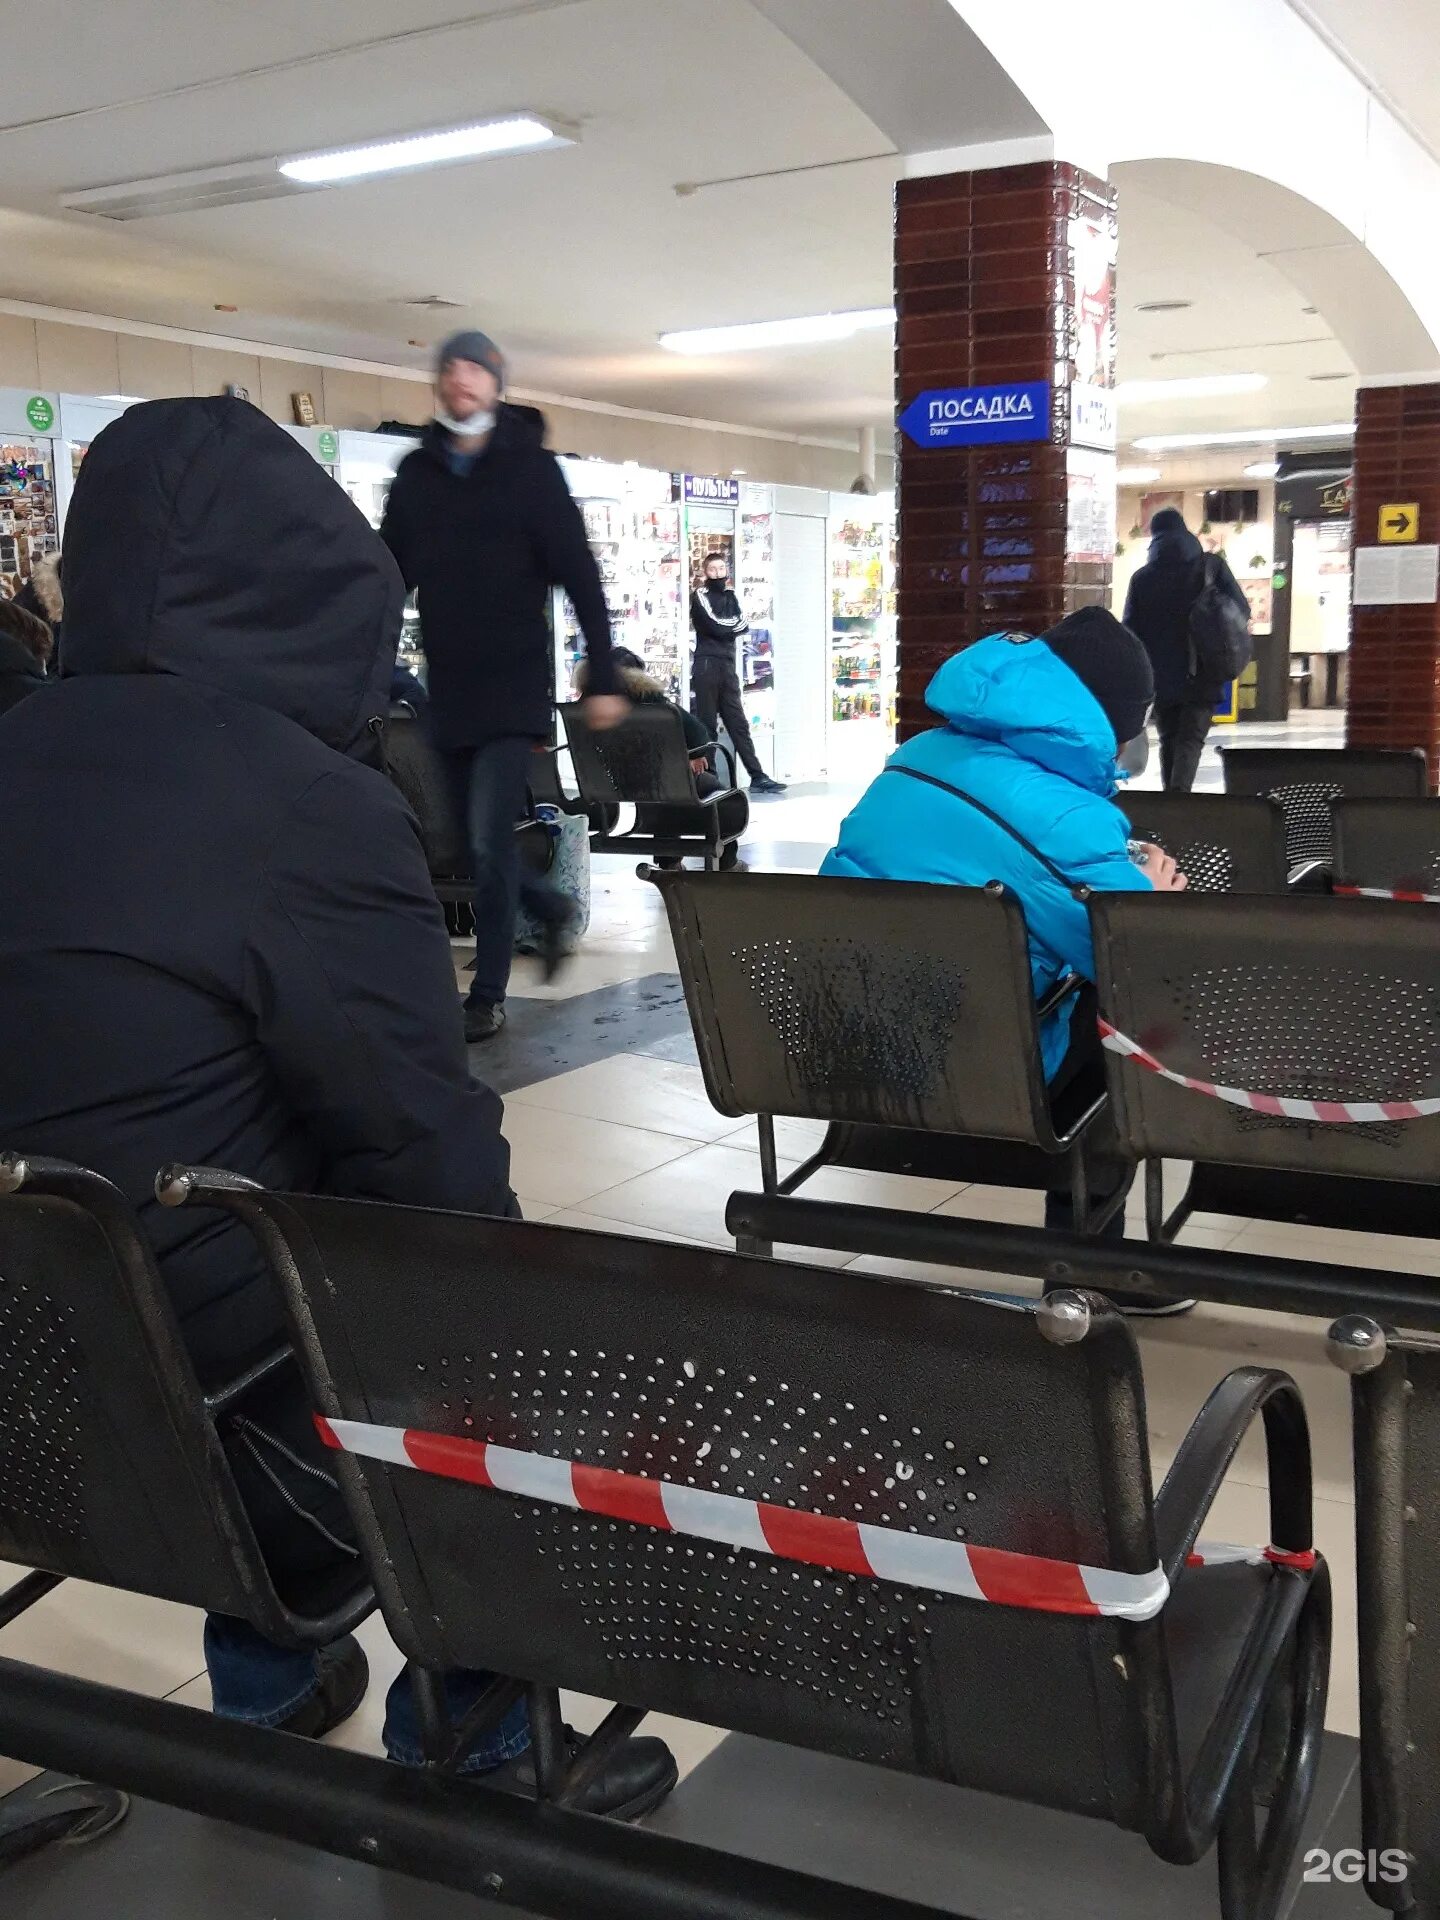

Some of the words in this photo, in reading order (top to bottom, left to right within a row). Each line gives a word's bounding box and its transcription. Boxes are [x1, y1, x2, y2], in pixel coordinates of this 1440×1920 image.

[929, 394, 1033, 420] ПОСАДКА
[930, 427, 949, 436] Date
[692, 477, 731, 498] ПУЛЬТЫ
